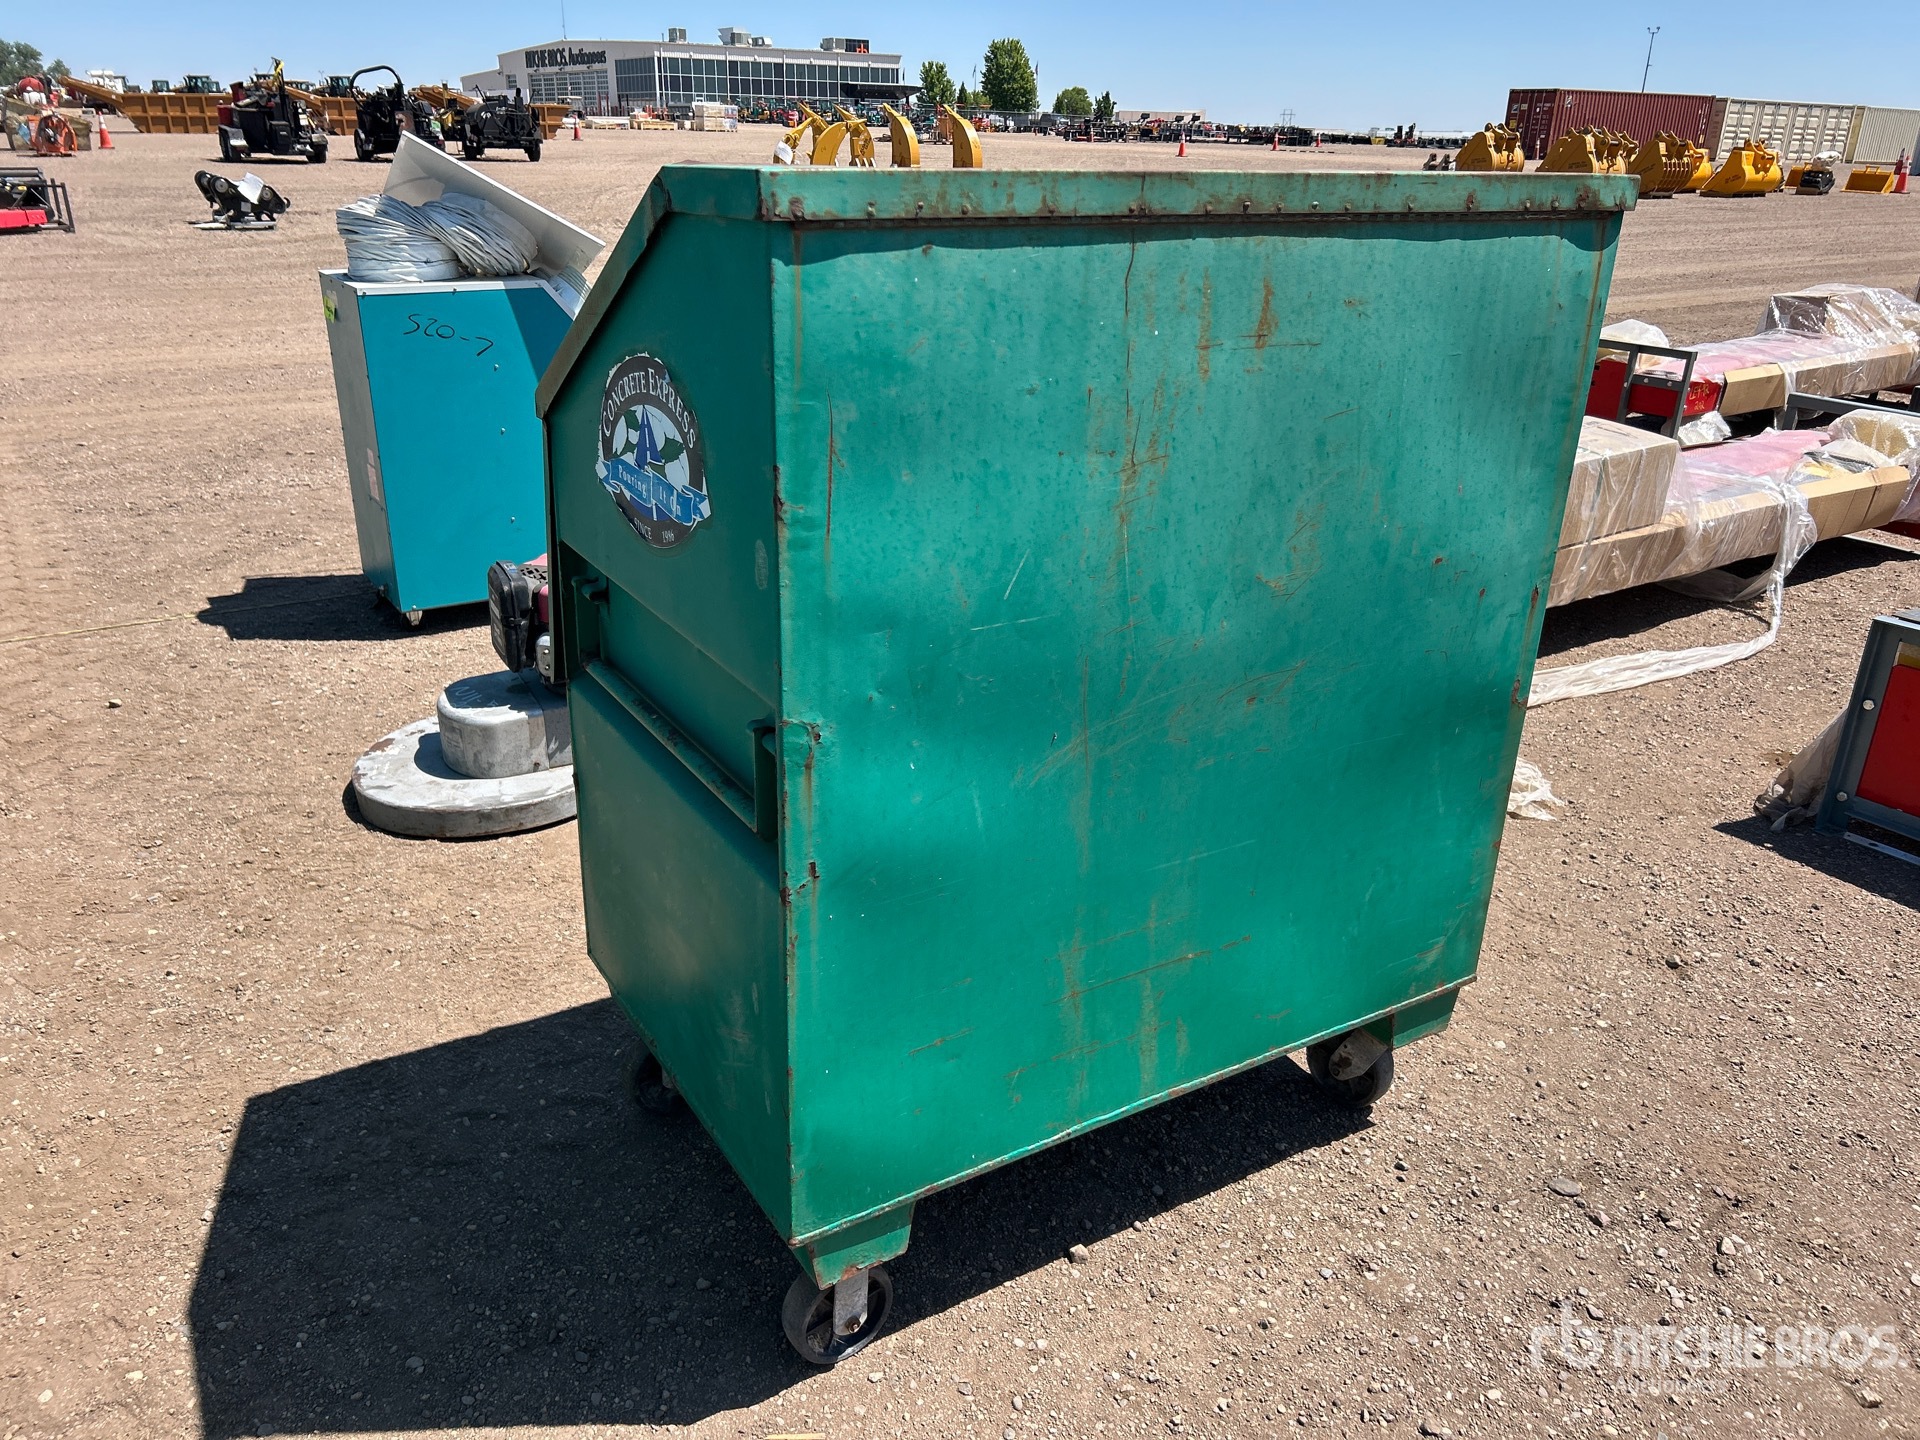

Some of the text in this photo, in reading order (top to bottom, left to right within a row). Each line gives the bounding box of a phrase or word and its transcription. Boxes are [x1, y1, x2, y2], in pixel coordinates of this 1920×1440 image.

[602, 367, 696, 449] CONCRETE EXPRESS
[618, 464, 647, 499] Pouring
[633, 517, 652, 540] SINCE
